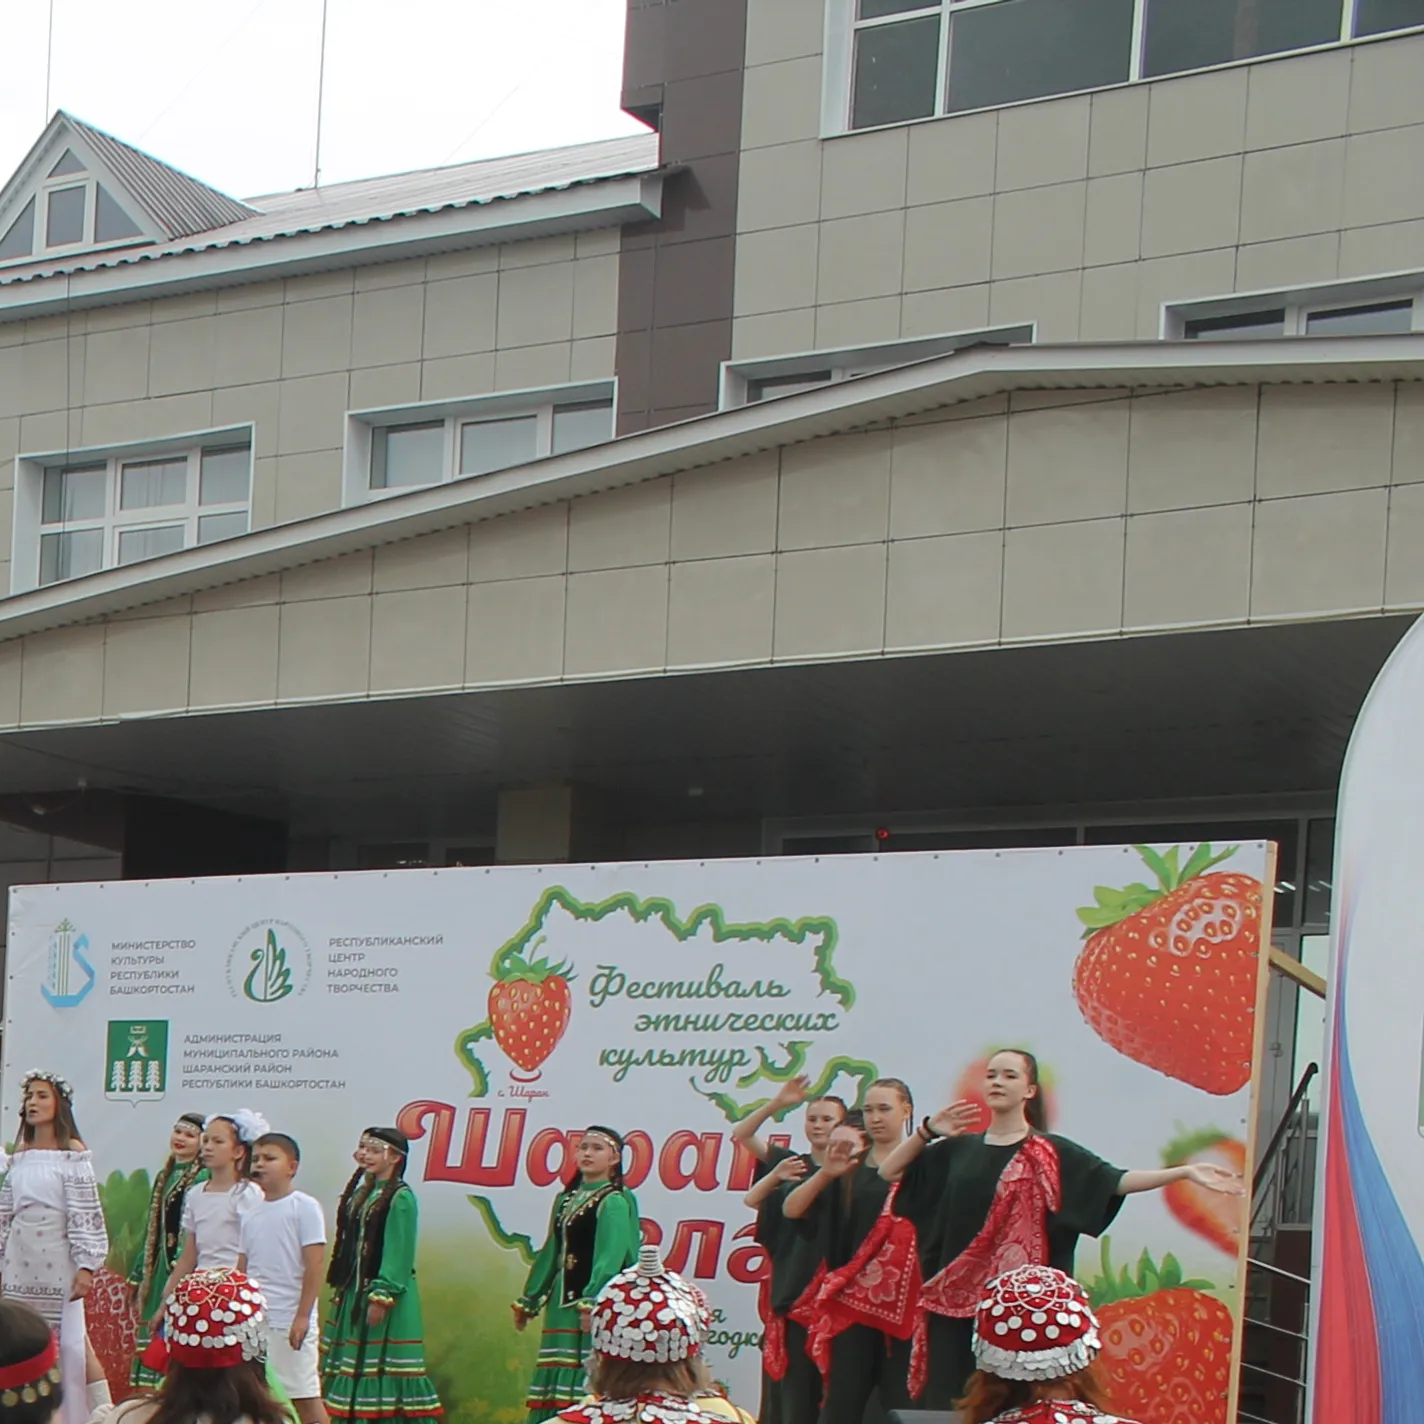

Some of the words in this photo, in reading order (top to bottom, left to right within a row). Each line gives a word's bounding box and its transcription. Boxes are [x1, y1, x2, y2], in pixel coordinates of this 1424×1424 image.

[111, 939, 197, 951] МИНИСТЕРСТВО
[328, 934, 444, 948] РЕСПУБЛИКАНСКИЙ
[110, 955, 165, 966] КУЛЬТУРЫ
[328, 952, 366, 963] ЦЕНТР
[110, 970, 180, 981] РЕСПУБЛИКИ
[327, 967, 399, 979] НАРОДНОГО
[109, 984, 195, 996] БАШКОРТОСТАН
[326, 983, 400, 994] ТВОРЧЕСТВА
[589, 963, 791, 1008] Фестиваль
[634, 1012, 840, 1033] этнических
[183, 1034, 282, 1045] АДМИНИСТРАЦИЯ
[183, 1048, 290, 1059] МУНИЦИПАЛЬНОГО
[292, 1047, 340, 1059] РАЙОНА
[182, 1062, 251, 1074] ШАРАНСКИЙ
[253, 1062, 293, 1074] РАЙОН
[599, 1046, 752, 1083] культур
[181, 1079, 253, 1090] РЕСПУБЛИКИ
[255, 1079, 346, 1090] БАШКОРТОСТАН
